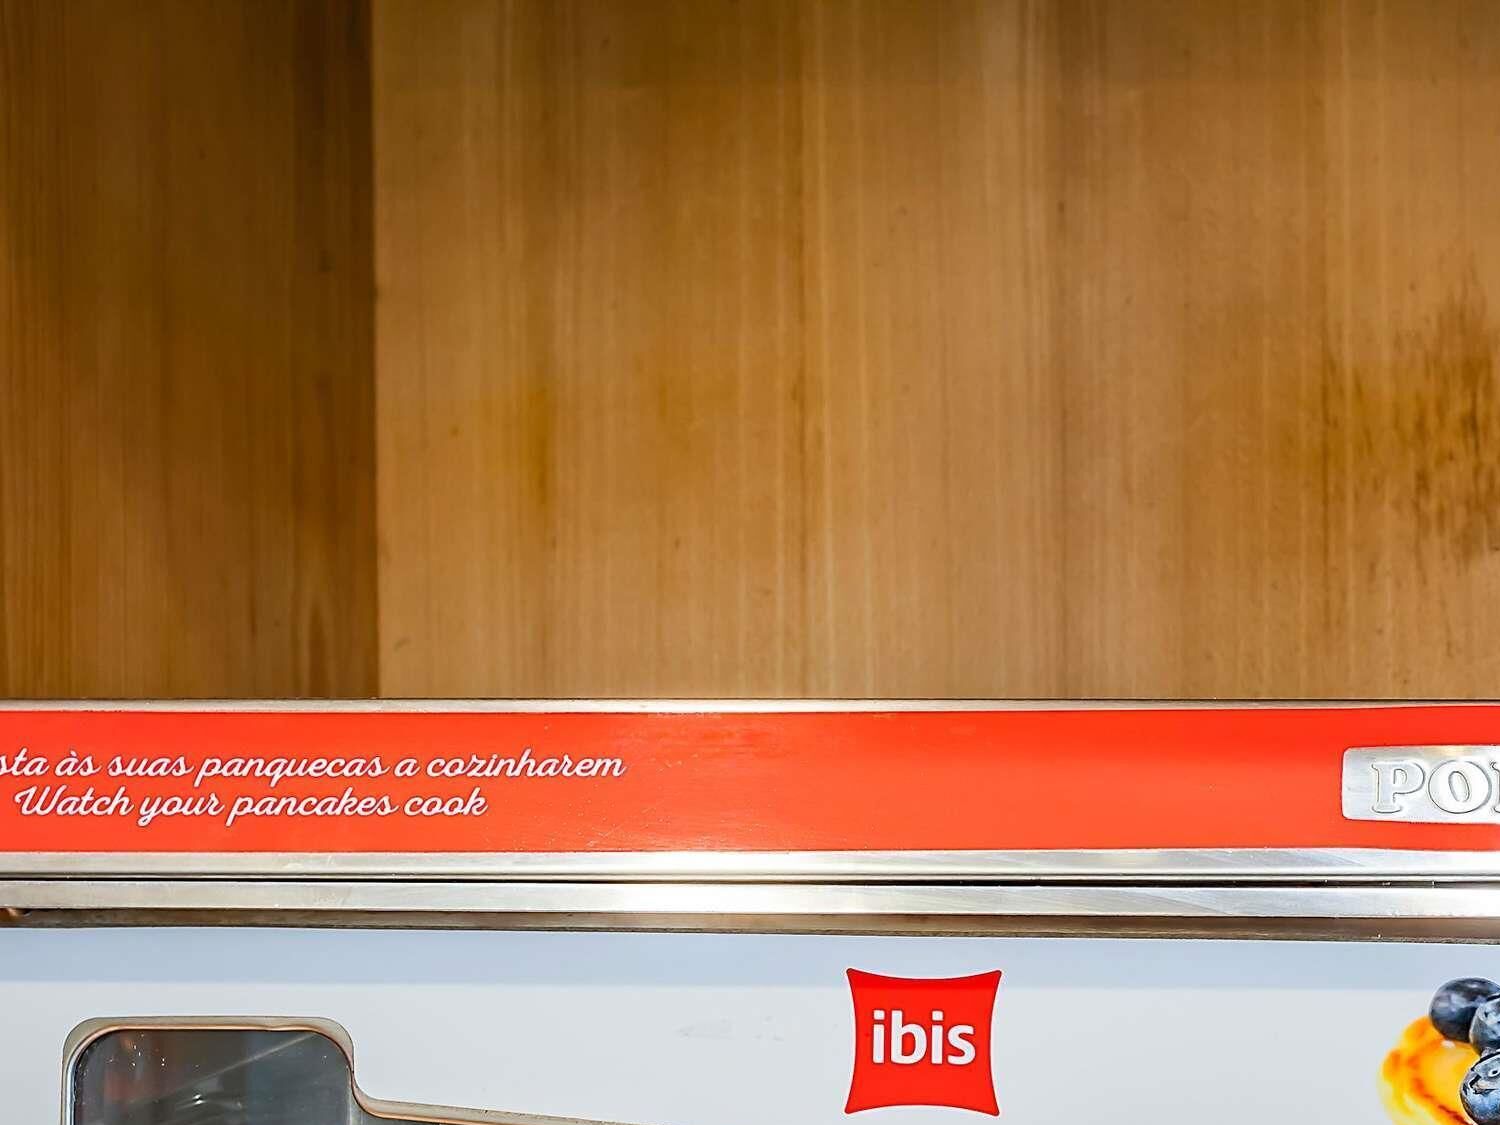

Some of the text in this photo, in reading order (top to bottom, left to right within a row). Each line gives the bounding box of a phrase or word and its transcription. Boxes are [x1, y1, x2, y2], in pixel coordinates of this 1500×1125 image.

[55, 750, 101, 777] às
[107, 756, 194, 777] suas
[194, 756, 390, 787] panquecas
[394, 758, 420, 777] a
[427, 749, 626, 777] cozinharem
[14, 785, 488, 827] Watch your pancakes cook
[872, 1009, 976, 1065] ibis
